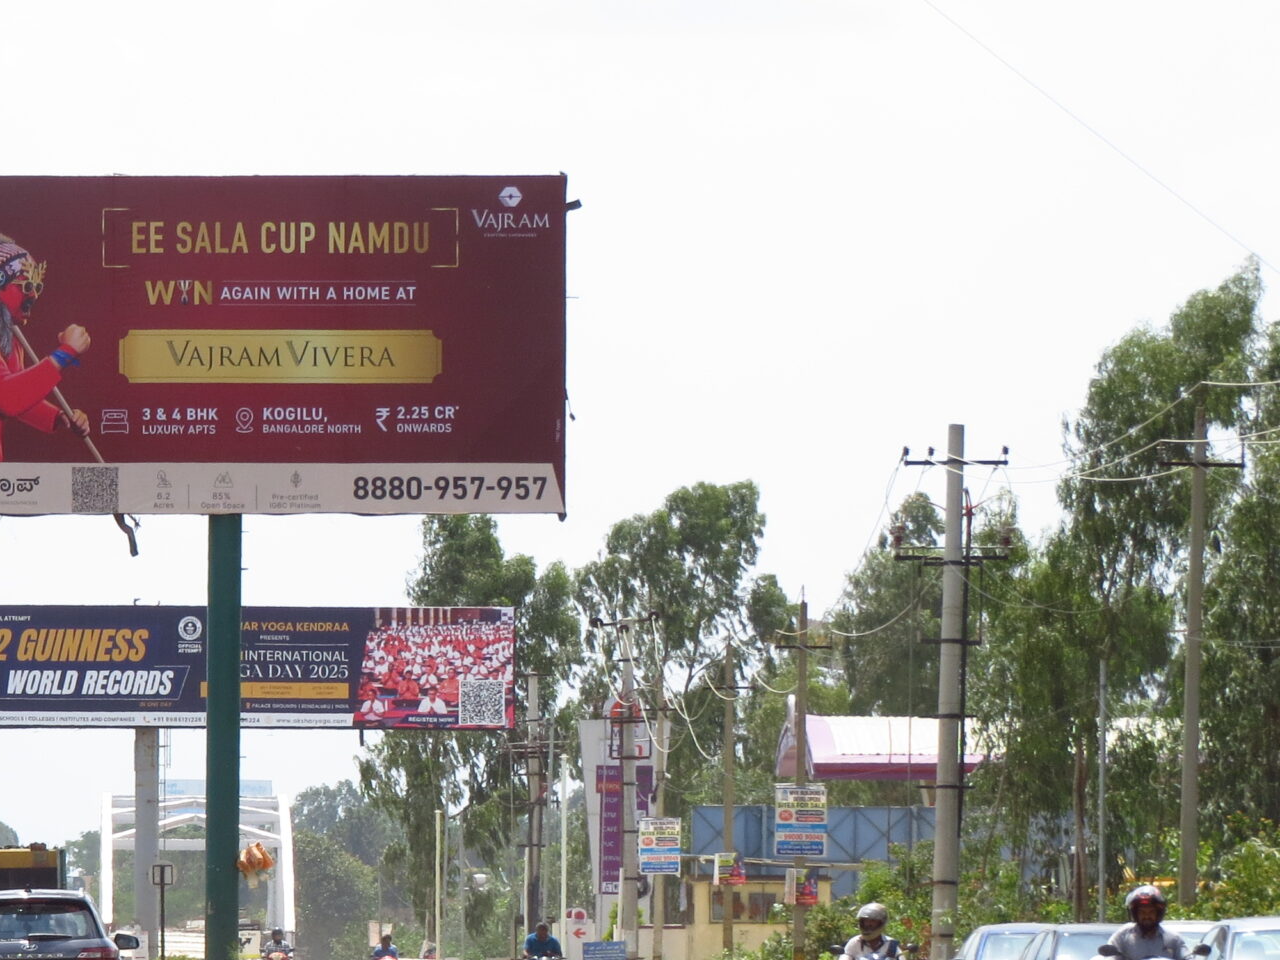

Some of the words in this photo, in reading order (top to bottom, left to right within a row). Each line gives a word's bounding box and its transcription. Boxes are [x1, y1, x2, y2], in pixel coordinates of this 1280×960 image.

[471, 208, 550, 232] VAJRAM
[131, 221, 165, 254] EE
[176, 221, 249, 254] SALA
[260, 221, 317, 254] CUP
[327, 221, 430, 254] NAMDU
[220, 286, 271, 300] AGAIN
[276, 286, 320, 300] WITH
[326, 286, 337, 300] A
[343, 286, 391, 300] HOME
[395, 286, 417, 300] AT
[166, 339, 282, 372] VAJRAM
[285, 339, 396, 368] VIVERA
[141, 407, 151, 421] 3
[156, 407, 168, 421] &
[171, 407, 182, 421] 4
[186, 407, 219, 421] BHK
[262, 407, 329, 423] KOGILU,
[396, 405, 430, 420] 2.25
[141, 424, 185, 435] LUXURY
[187, 424, 217, 435] APTS
[262, 423, 325, 434] BANGALORE
[327, 424, 362, 434] NORTH
[396, 422, 452, 433] ONWARDS
[352, 475, 548, 501] 8880-957-957
[152, 502, 175, 510] Acres
[200, 502, 221, 511] Open
[222, 502, 246, 511] Space
[261, 621, 294, 632] YOGA
[296, 621, 350, 632] KENDRAA
[16, 628, 150, 662] GUINNESS
[244, 650, 349, 662] INTERNATIONAL
[240, 664, 264, 678] GA
[268, 664, 305, 679] DAY
[309, 664, 349, 679] 2025
[6, 669, 79, 695] WORLD
[81, 669, 175, 696] RECORDS
